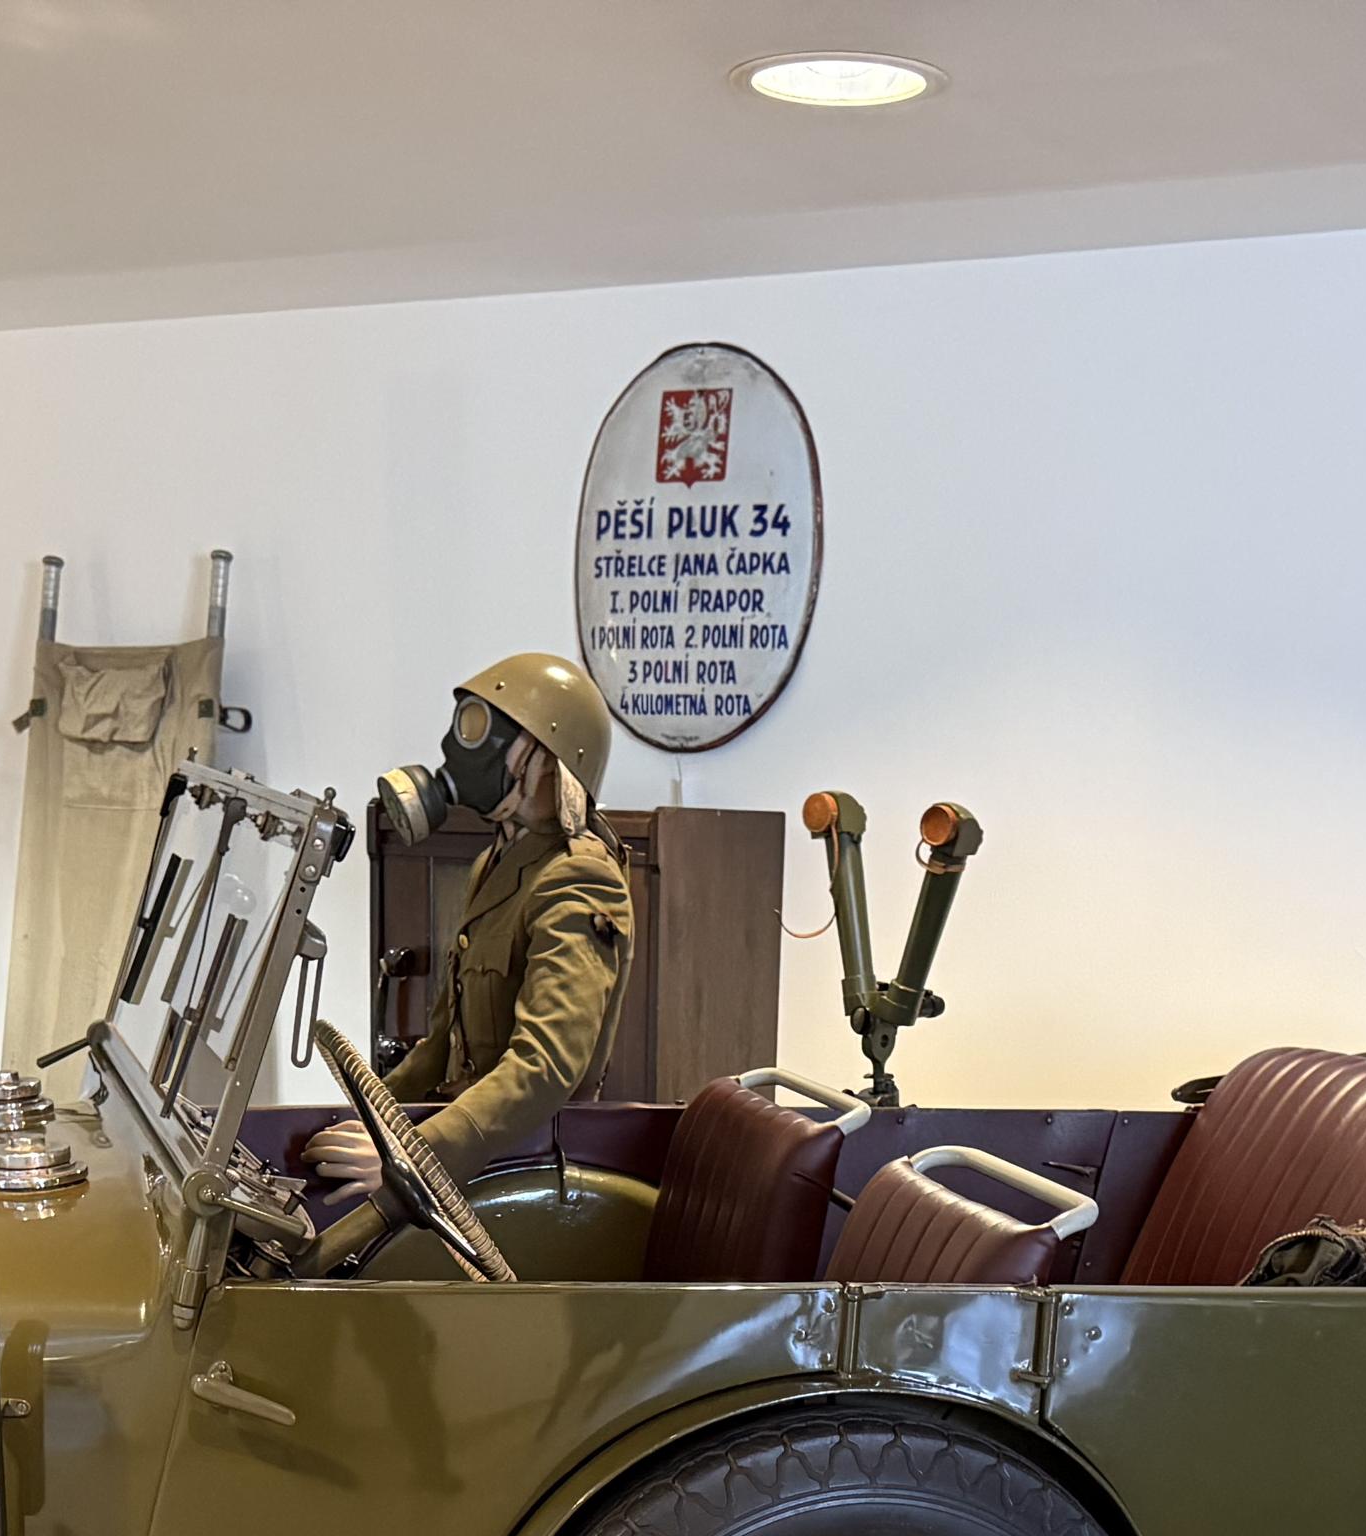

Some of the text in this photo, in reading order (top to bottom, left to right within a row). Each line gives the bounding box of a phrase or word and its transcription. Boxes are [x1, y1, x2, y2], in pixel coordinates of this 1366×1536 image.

[595, 497, 791, 540] PĚŠÍ PLUK 34
[595, 547, 791, 583] STŘELCE JANA ČAPKA
[629, 582, 679, 614] POLNÍ
[688, 588, 765, 613] PRAPOR
[599, 618, 637, 649] POLNÍ
[641, 625, 675, 649] ROTA
[685, 625, 698, 648] 2.
[702, 616, 745, 649] POLNÍ
[749, 624, 789, 651] ROTA
[628, 653, 737, 684] 3 POLNÍ ROTA
[620, 687, 753, 716] 4 KULOMETNÁ ROTA
